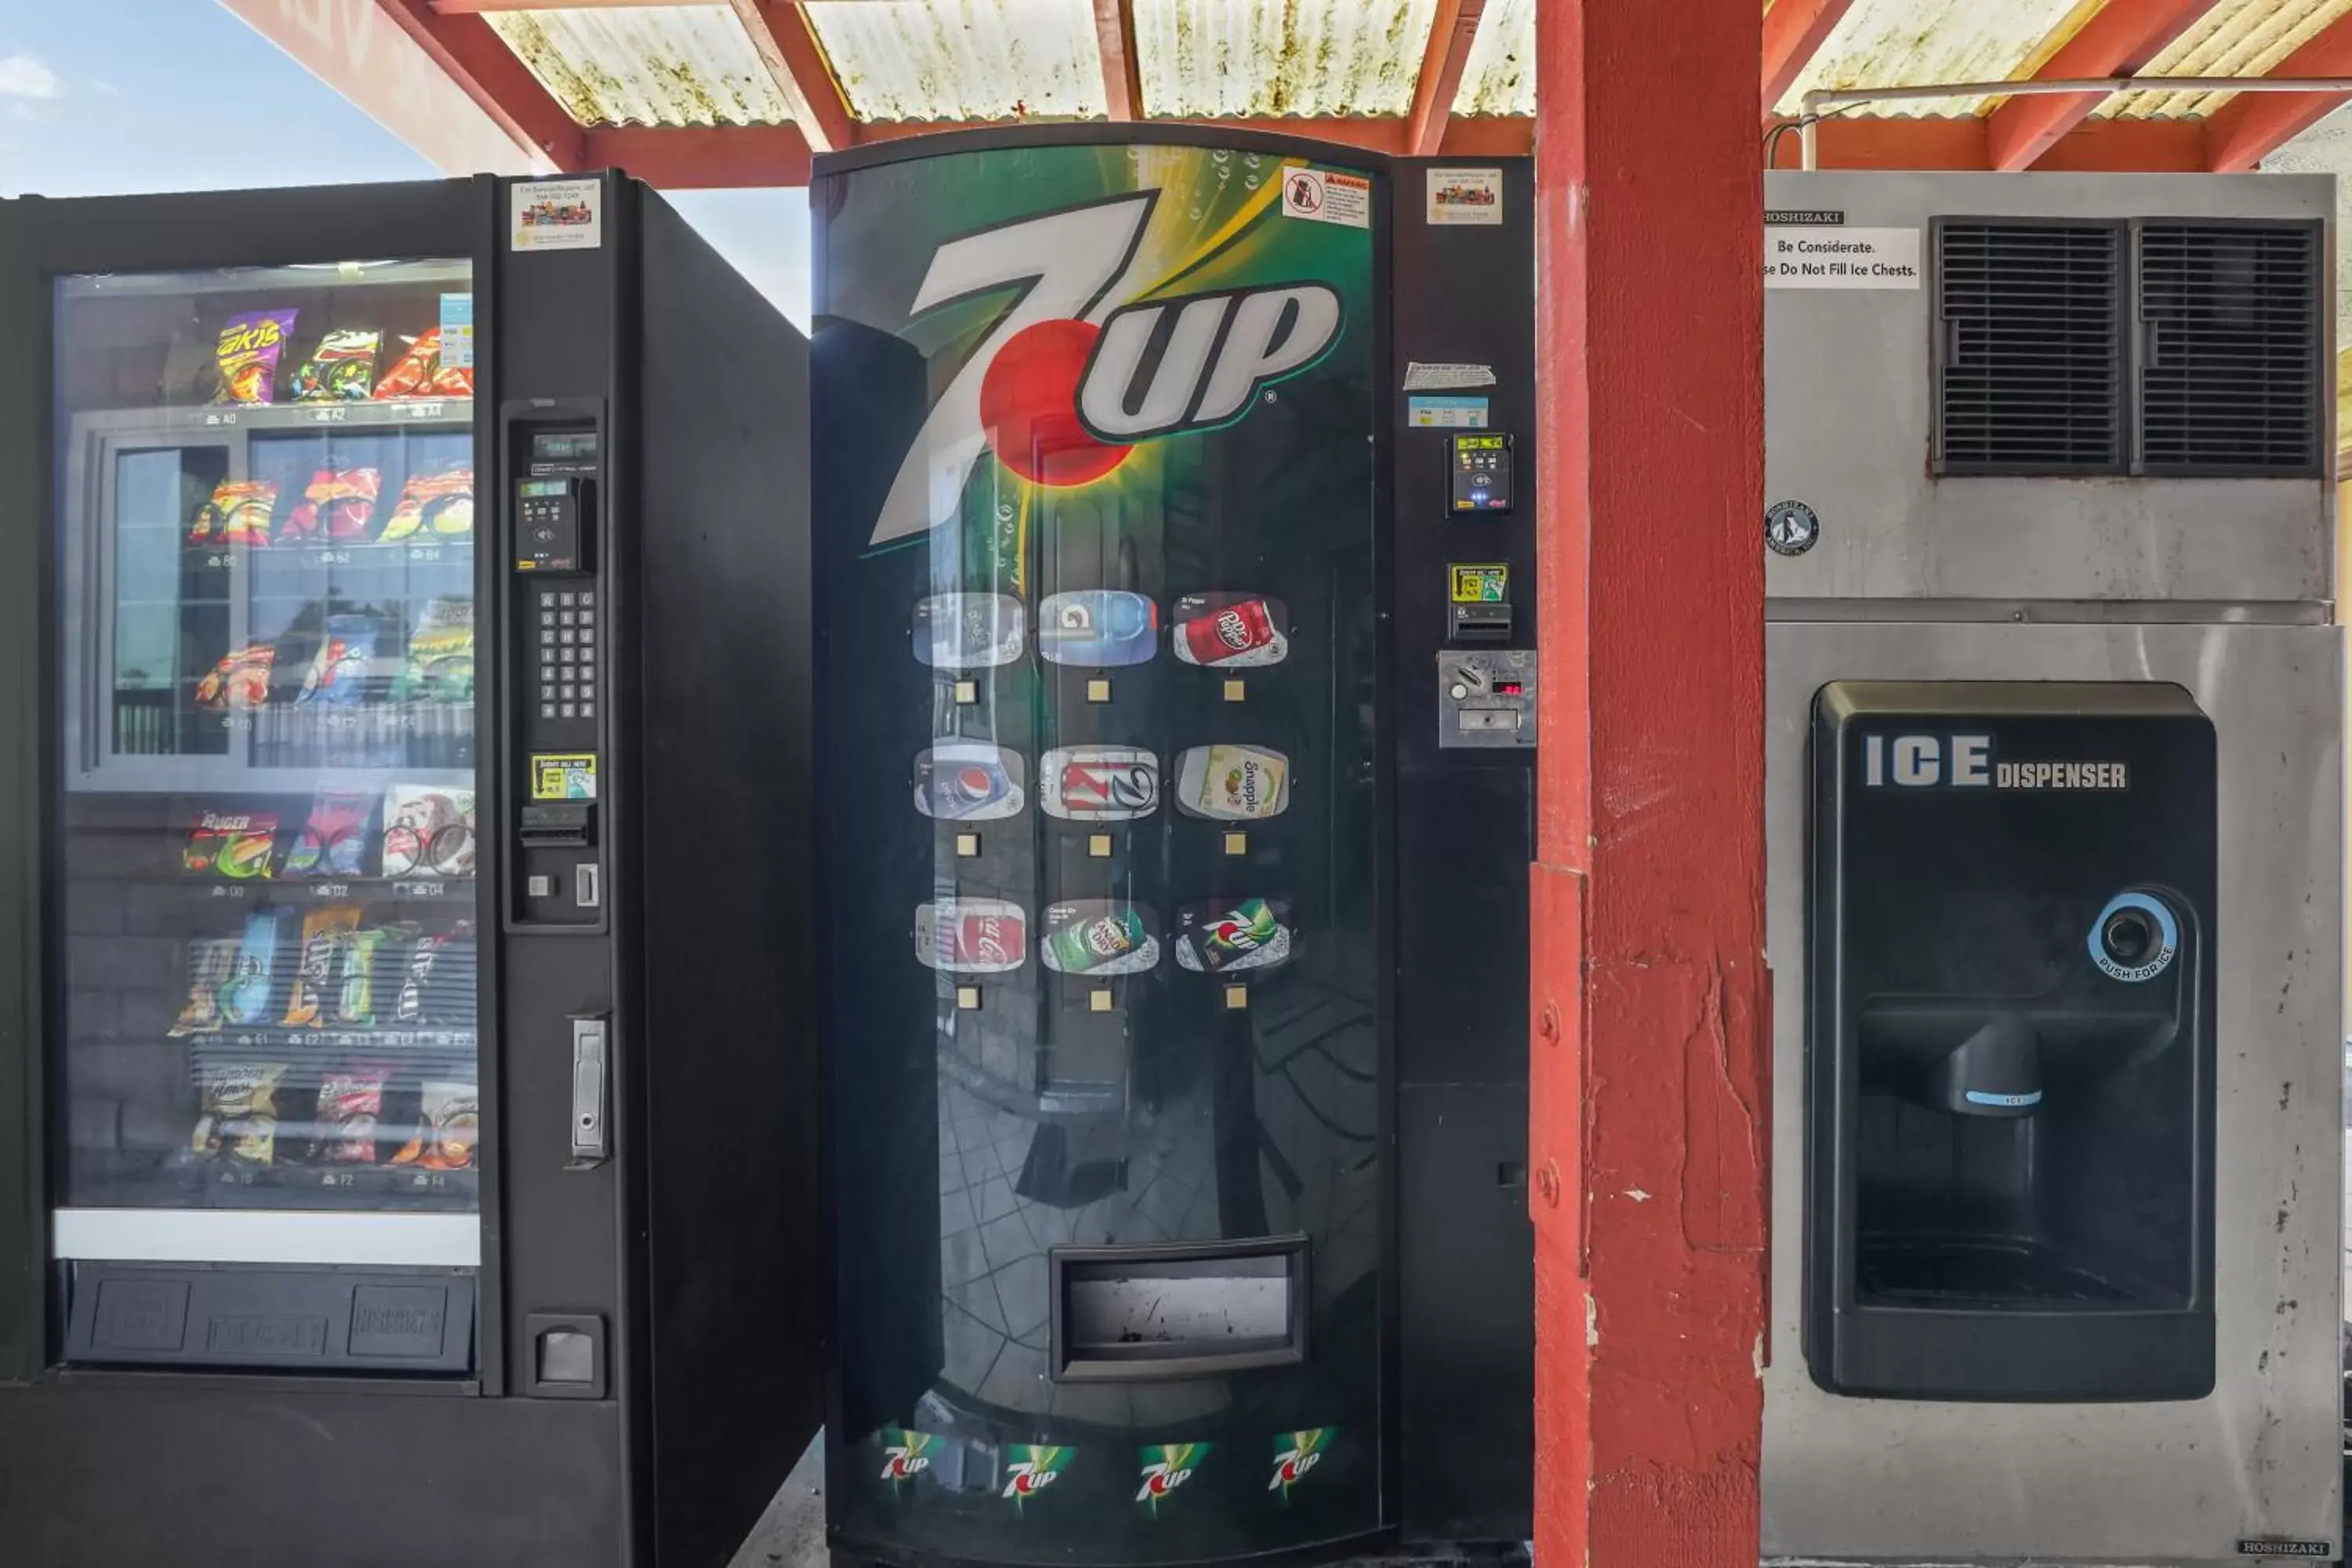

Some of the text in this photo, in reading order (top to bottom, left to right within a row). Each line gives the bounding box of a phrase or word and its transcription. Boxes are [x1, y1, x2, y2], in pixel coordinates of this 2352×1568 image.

[1777, 240, 1876, 253] Be Considerate.
[1780, 263, 1798, 274] Do
[1802, 263, 1825, 274] Not
[1829, 263, 1846, 274] Fill
[1851, 263, 1868, 275] Ice
[1872, 263, 1917, 276] Chests.
[1866, 735, 2126, 788] ICE DISPENSER
[1244, 760, 1260, 813] Snapple
[2100, 946, 2172, 979] PUSH FOR ICE
[1002, 1461, 1057, 1498] 7UP
[1136, 1461, 1192, 1501] 7UP
[1269, 1449, 1320, 1490] 7UP
[2244, 1542, 2324, 1554] HOSHIZAKI
